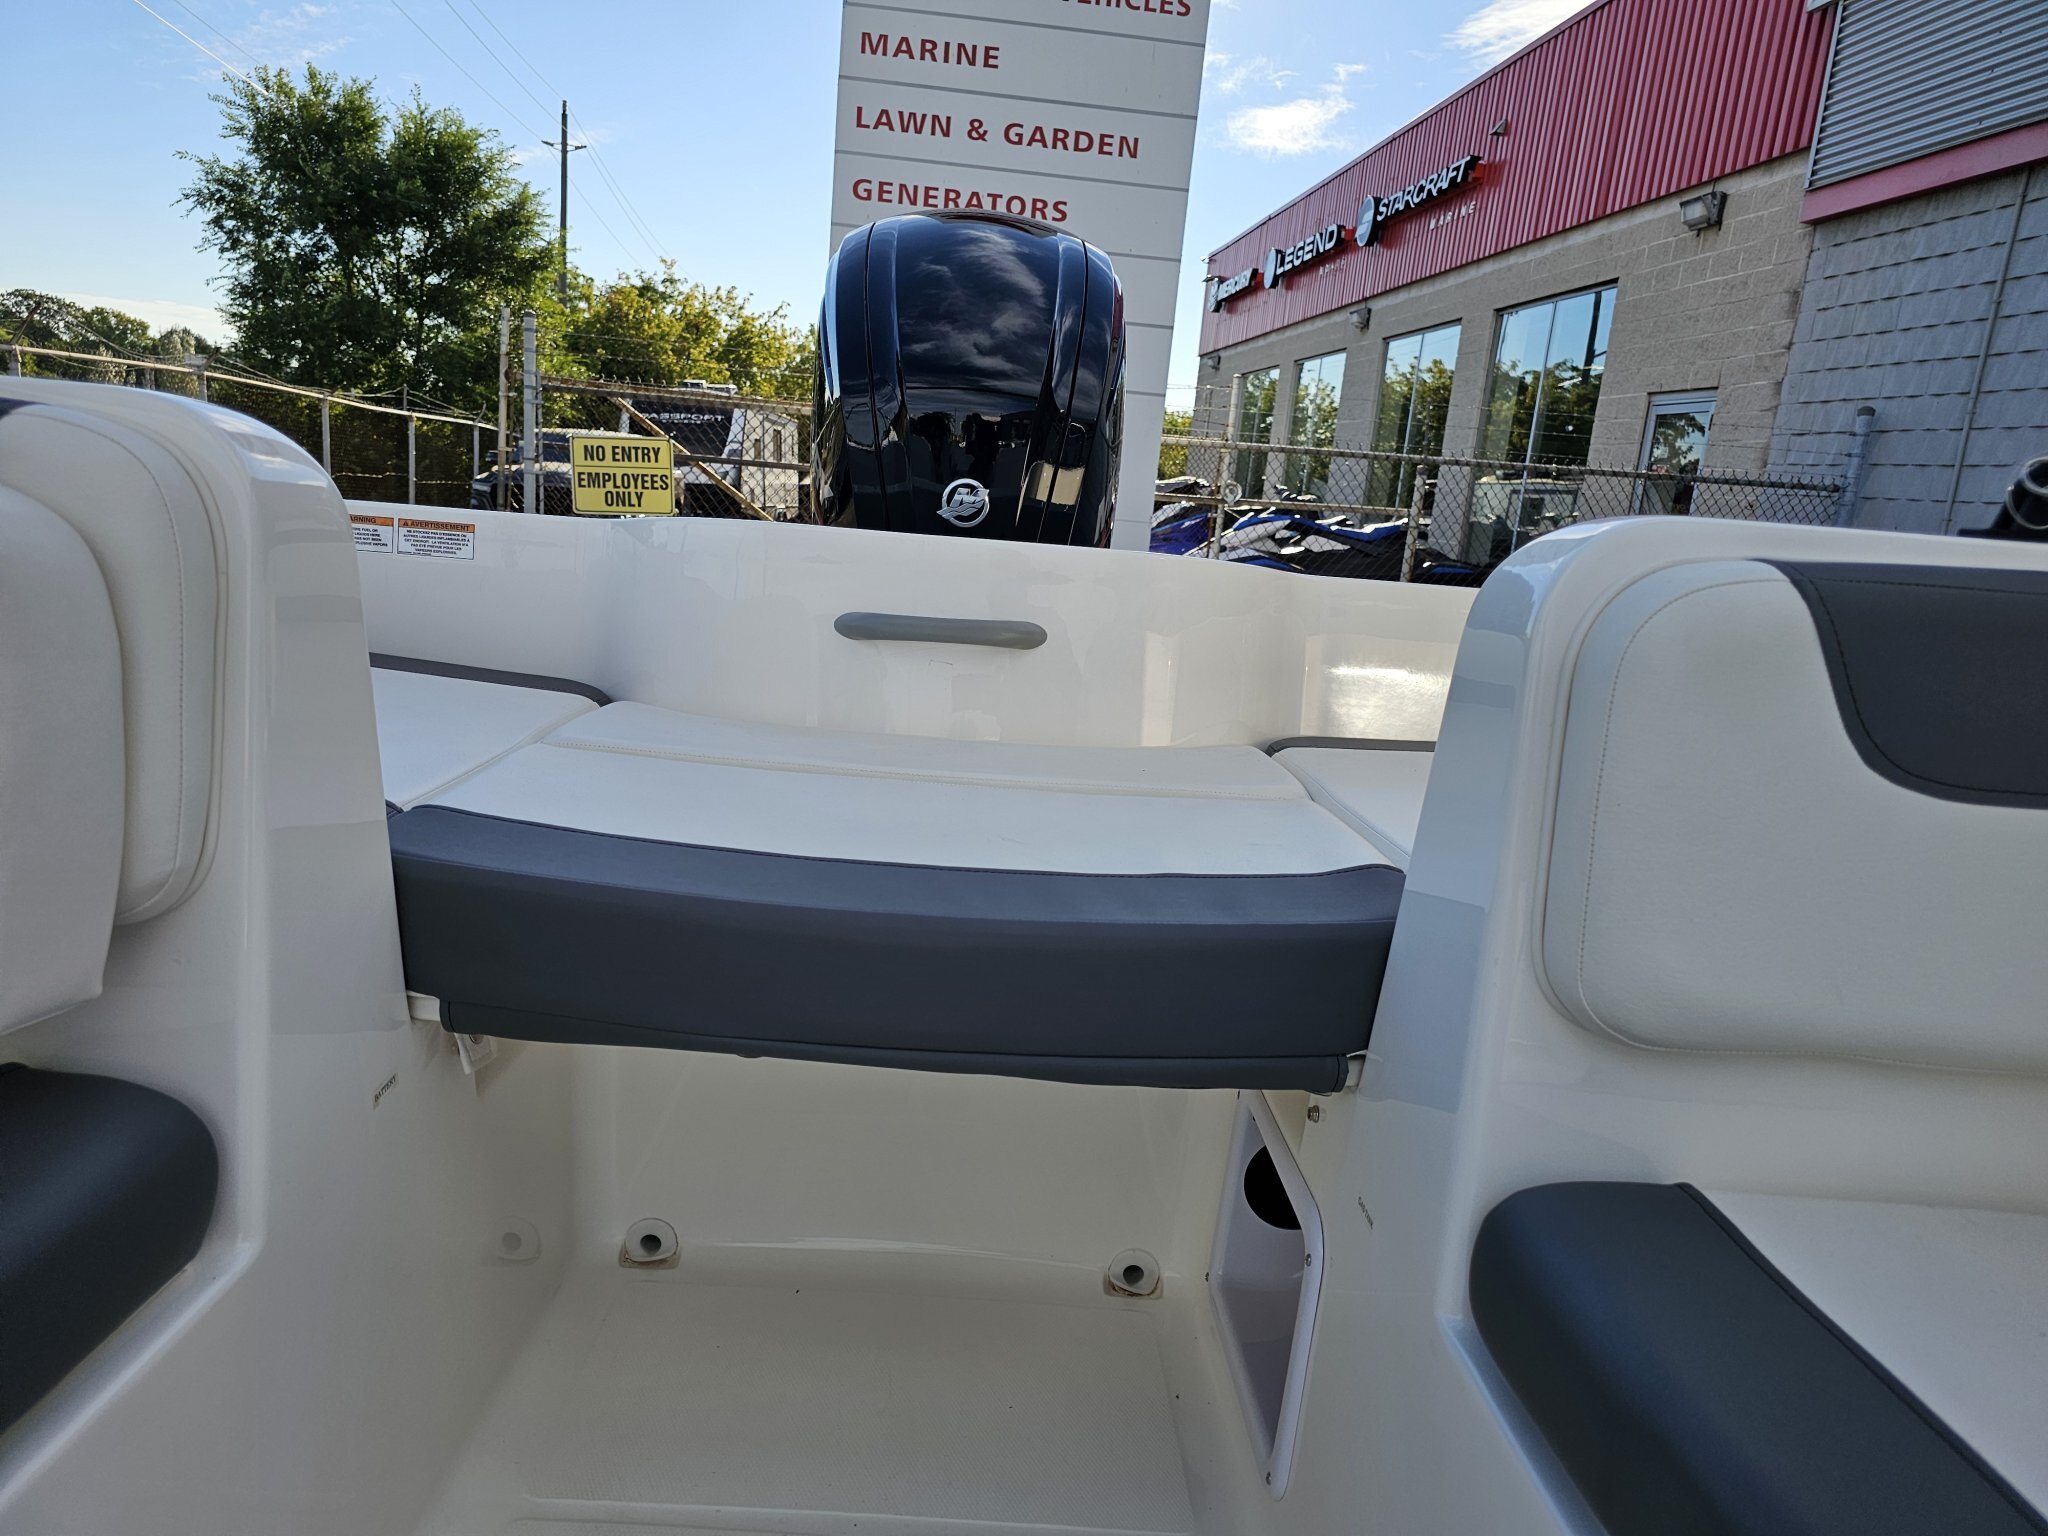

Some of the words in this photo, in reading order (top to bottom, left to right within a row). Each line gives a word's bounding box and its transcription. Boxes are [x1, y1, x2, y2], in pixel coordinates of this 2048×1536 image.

[860, 31, 1000, 69] MARINE
[855, 106, 952, 138] LAWN
[966, 118, 989, 142] &
[1003, 122, 1140, 160] GARDEN
[851, 178, 1069, 223] GENERATORS
[1376, 155, 1471, 222] STARCRAFT
[1429, 201, 1476, 231] MARINE
[1275, 223, 1338, 276] LEGEND
[583, 444, 606, 462] NO
[611, 445, 661, 463] ENTRY
[577, 471, 669, 491] EMPLOYEES
[604, 490, 644, 508] ONLY
[411, 520, 470, 532] AVERTISSEMENT
[374, 1075, 396, 1103] BATTERY
